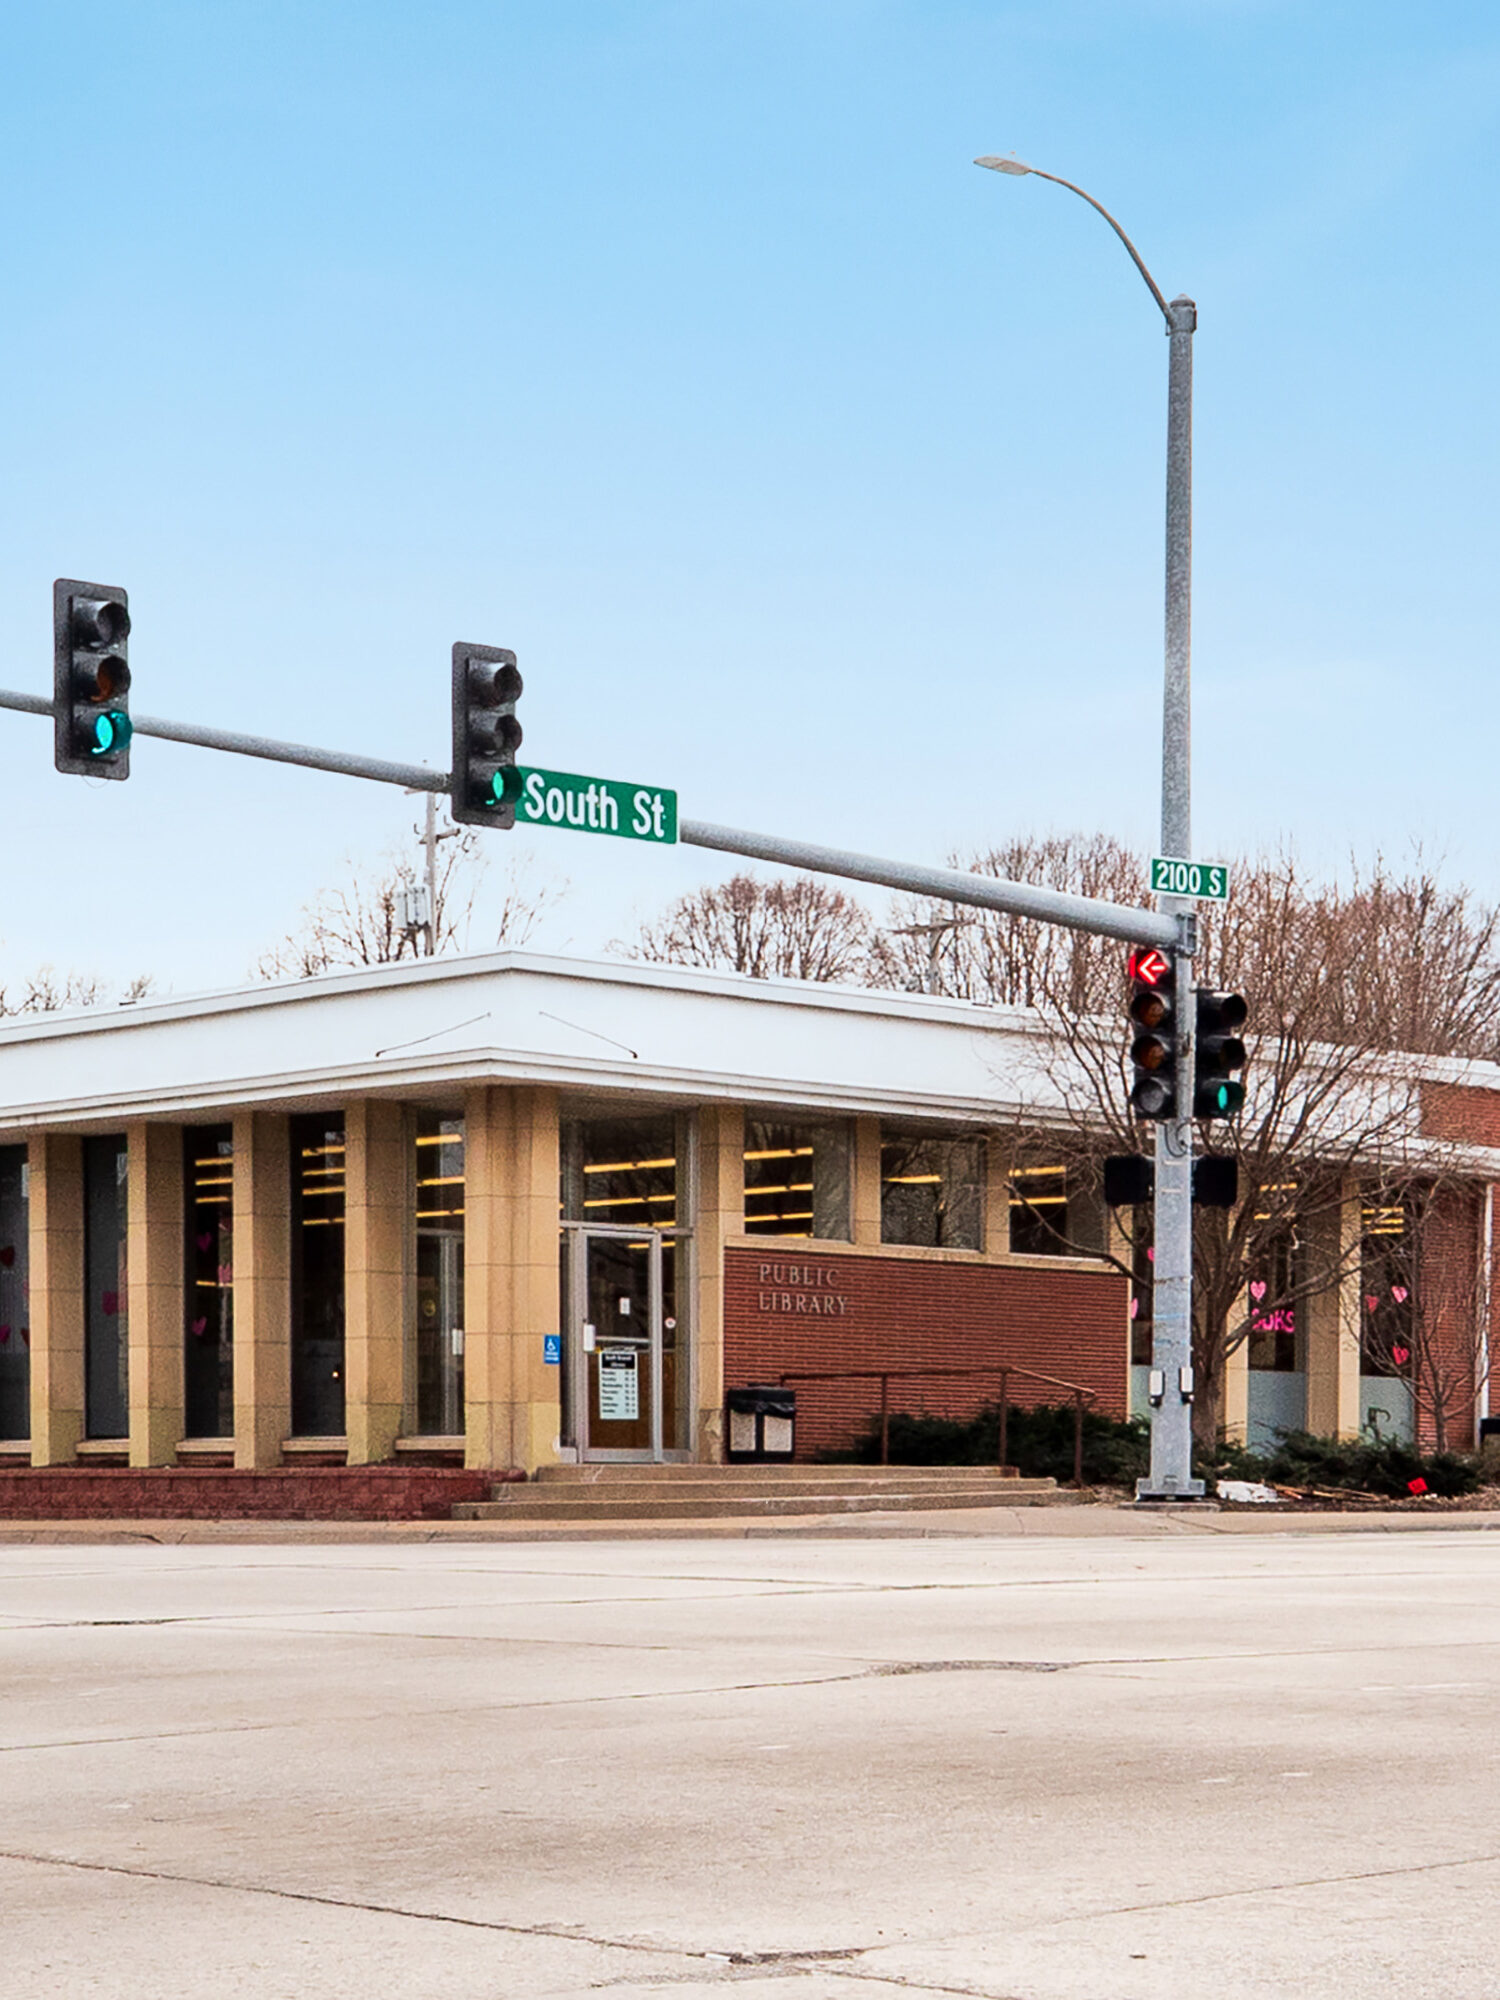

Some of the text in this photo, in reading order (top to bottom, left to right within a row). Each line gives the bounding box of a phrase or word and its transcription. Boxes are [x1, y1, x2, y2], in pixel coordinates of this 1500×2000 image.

[524, 772, 665, 838] South St
[1156, 861, 1222, 896] 2100 S
[759, 1264, 840, 1287] PUBLIC
[759, 1292, 848, 1315] LIBRARY
